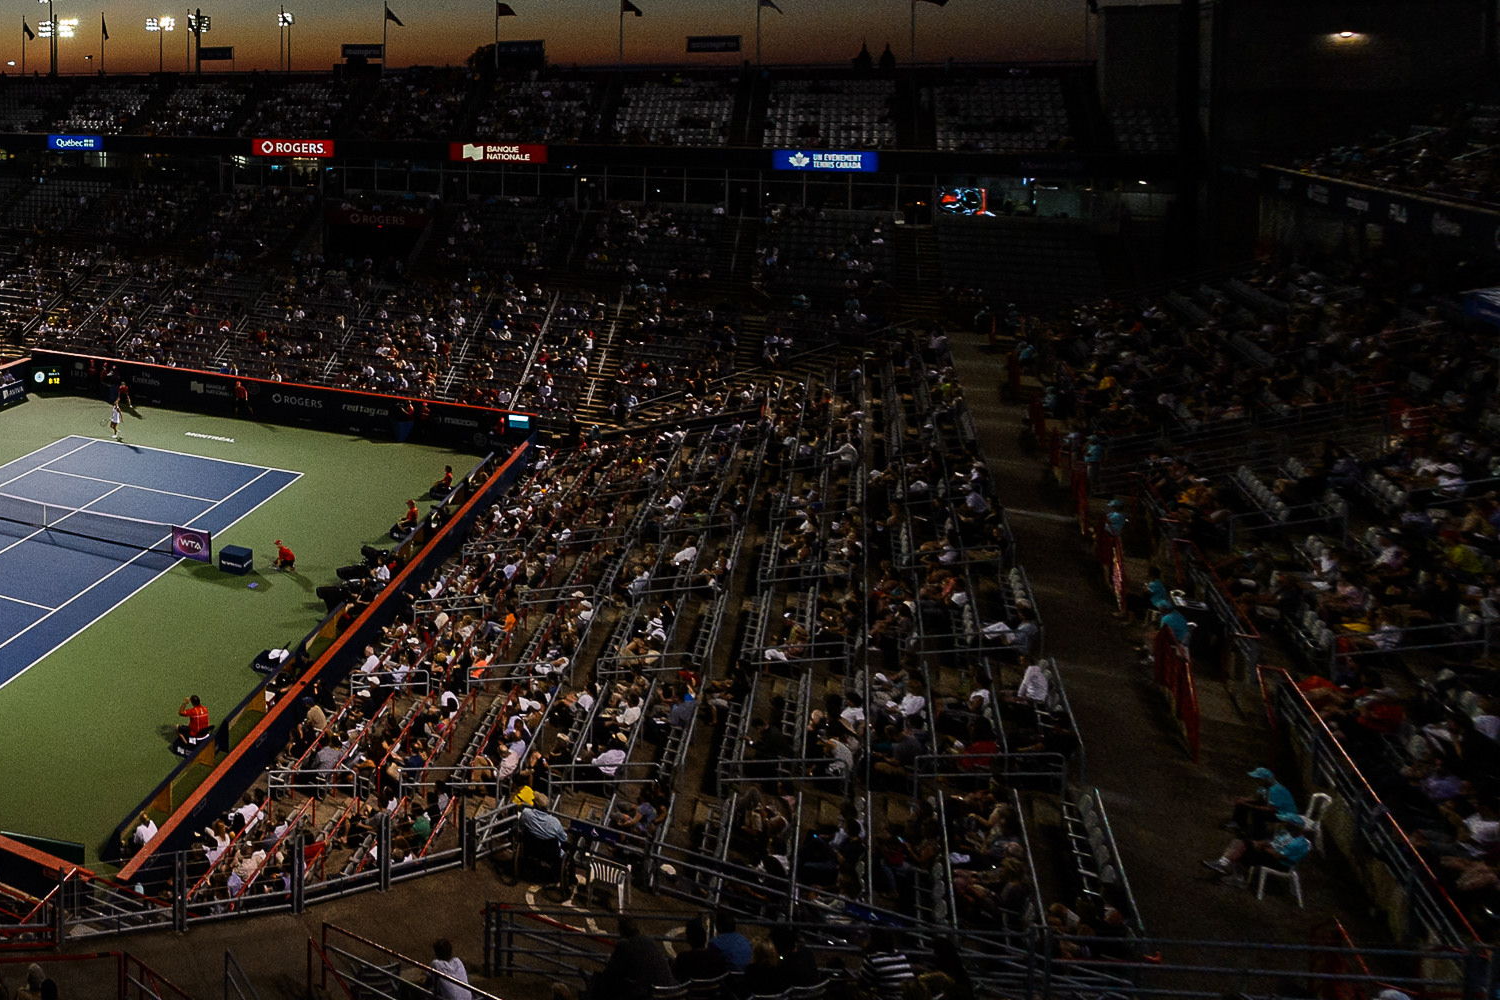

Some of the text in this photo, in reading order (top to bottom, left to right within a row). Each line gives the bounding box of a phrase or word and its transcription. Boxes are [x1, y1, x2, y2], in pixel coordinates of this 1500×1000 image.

[56, 139, 83, 147] Québec
[276, 142, 324, 154] ROGERS
[486, 145, 520, 153] BANQUE
[486, 153, 531, 161] NATIONALE
[813, 161, 862, 169] TENNIS CANADA
[362, 214, 405, 225] ROGERS
[284, 395, 323, 408] ROGERS
[180, 538, 201, 550] WTA
